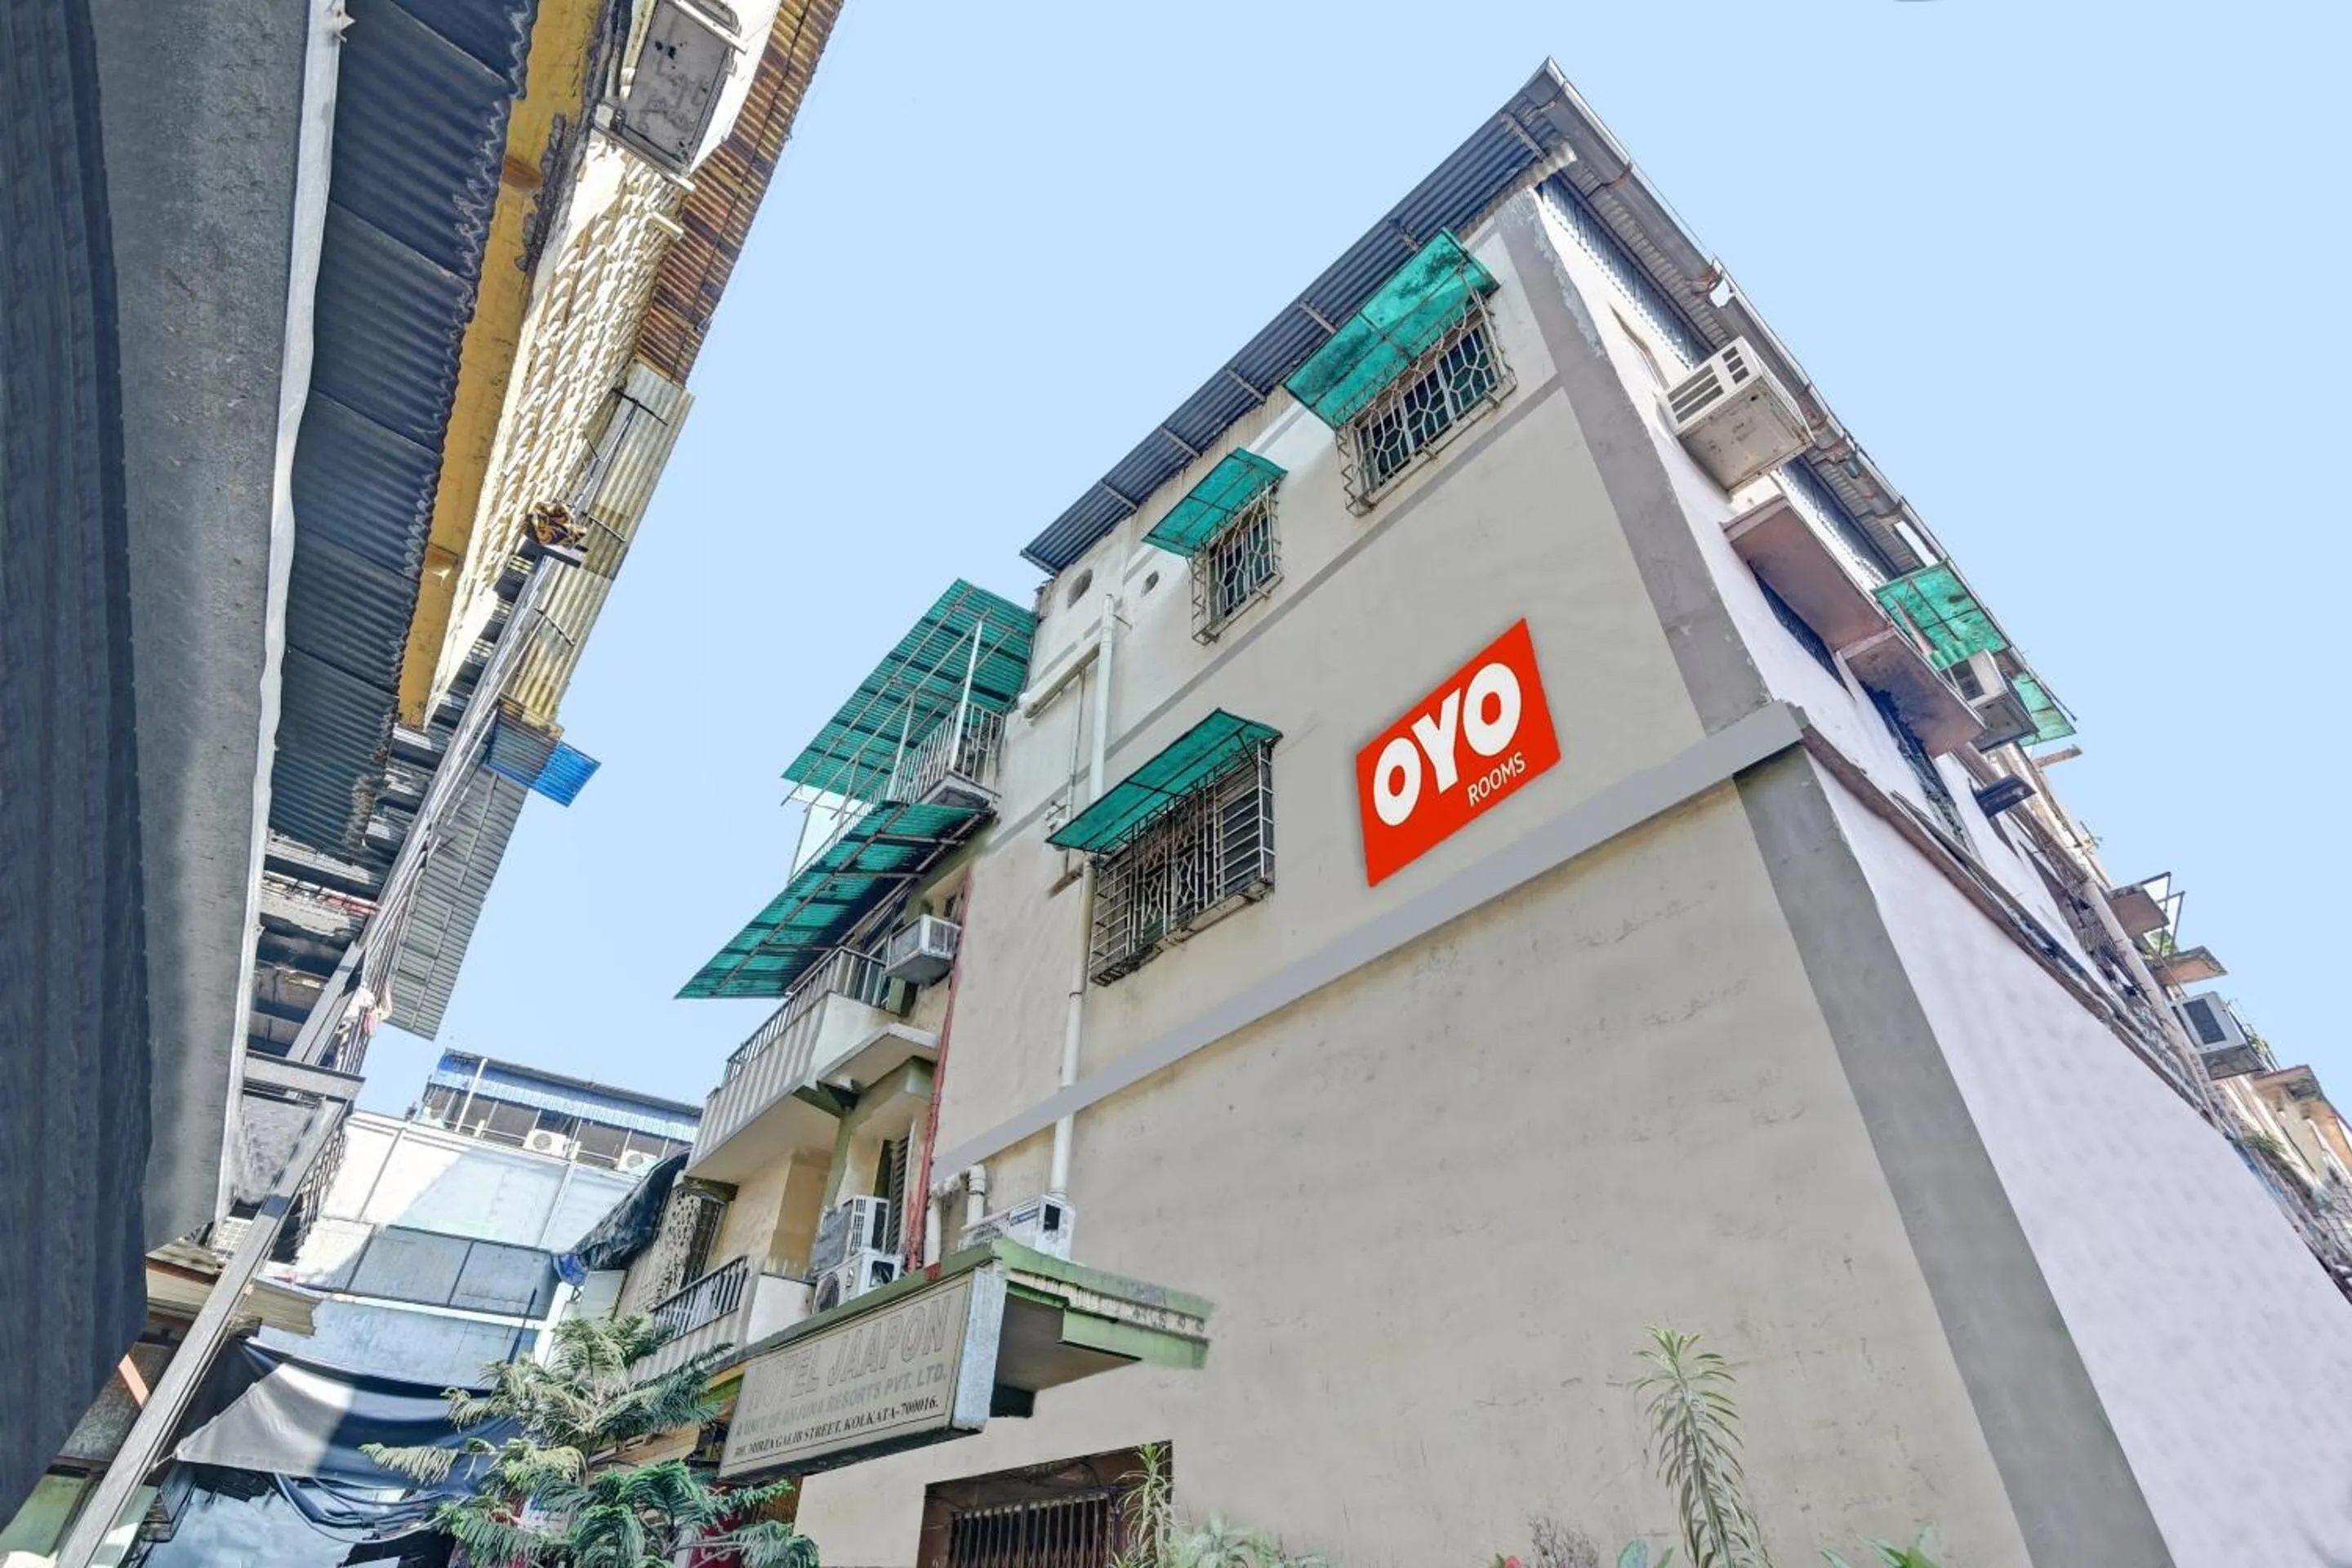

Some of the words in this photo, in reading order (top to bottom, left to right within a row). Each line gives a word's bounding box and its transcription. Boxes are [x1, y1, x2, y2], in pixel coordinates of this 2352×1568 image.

[1373, 662, 1522, 826] OYO
[1467, 751, 1526, 808] ROOMS
[827, 1295, 951, 1387] JAAPON
[826, 1380, 881, 1413] RESORTS
[884, 1371, 911, 1396] PVT.
[917, 1363, 947, 1388] LTD.
